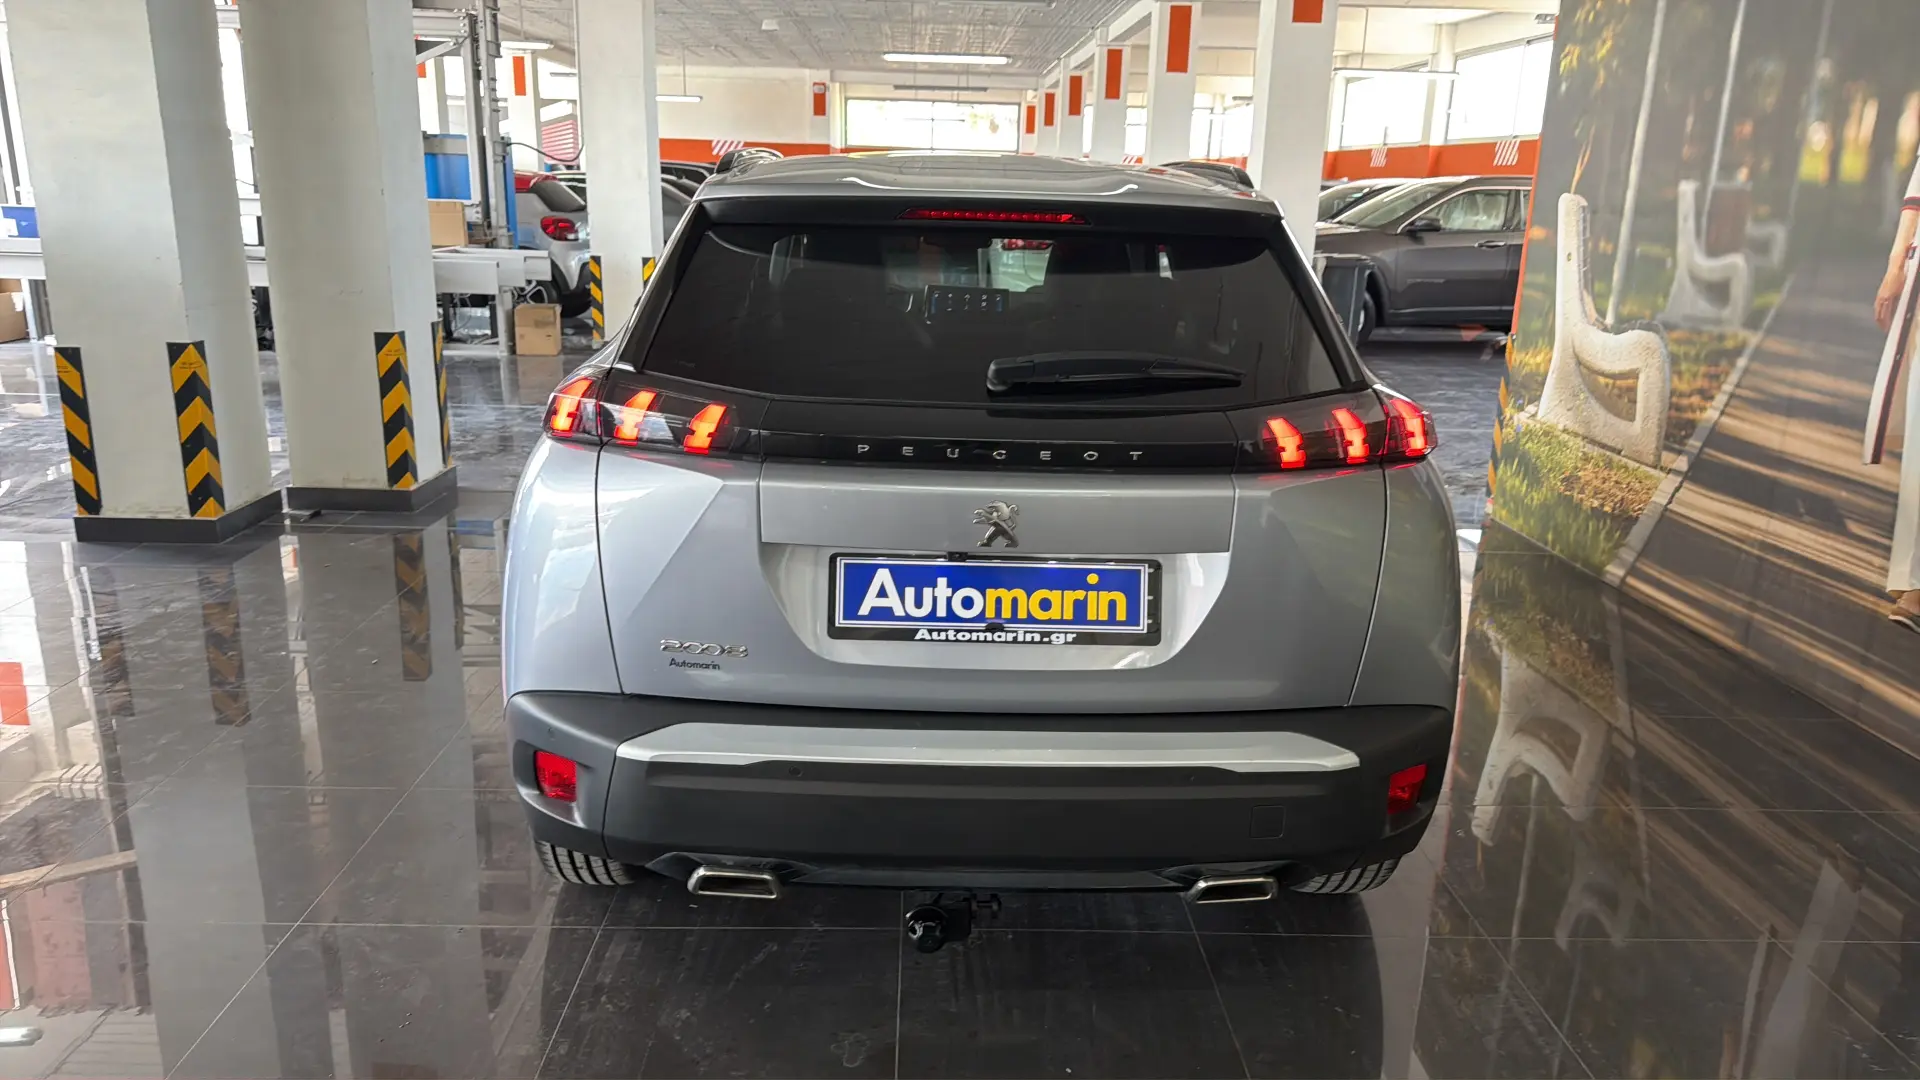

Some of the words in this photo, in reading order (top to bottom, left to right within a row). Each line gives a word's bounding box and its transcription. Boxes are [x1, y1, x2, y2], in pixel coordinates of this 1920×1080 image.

[857, 444, 1143, 462] PEUGEOT
[856, 567, 1128, 622] Automarin
[914, 628, 1077, 645] Automarin.gr
[659, 638, 749, 658] 2008
[669, 657, 721, 671] Automarin
